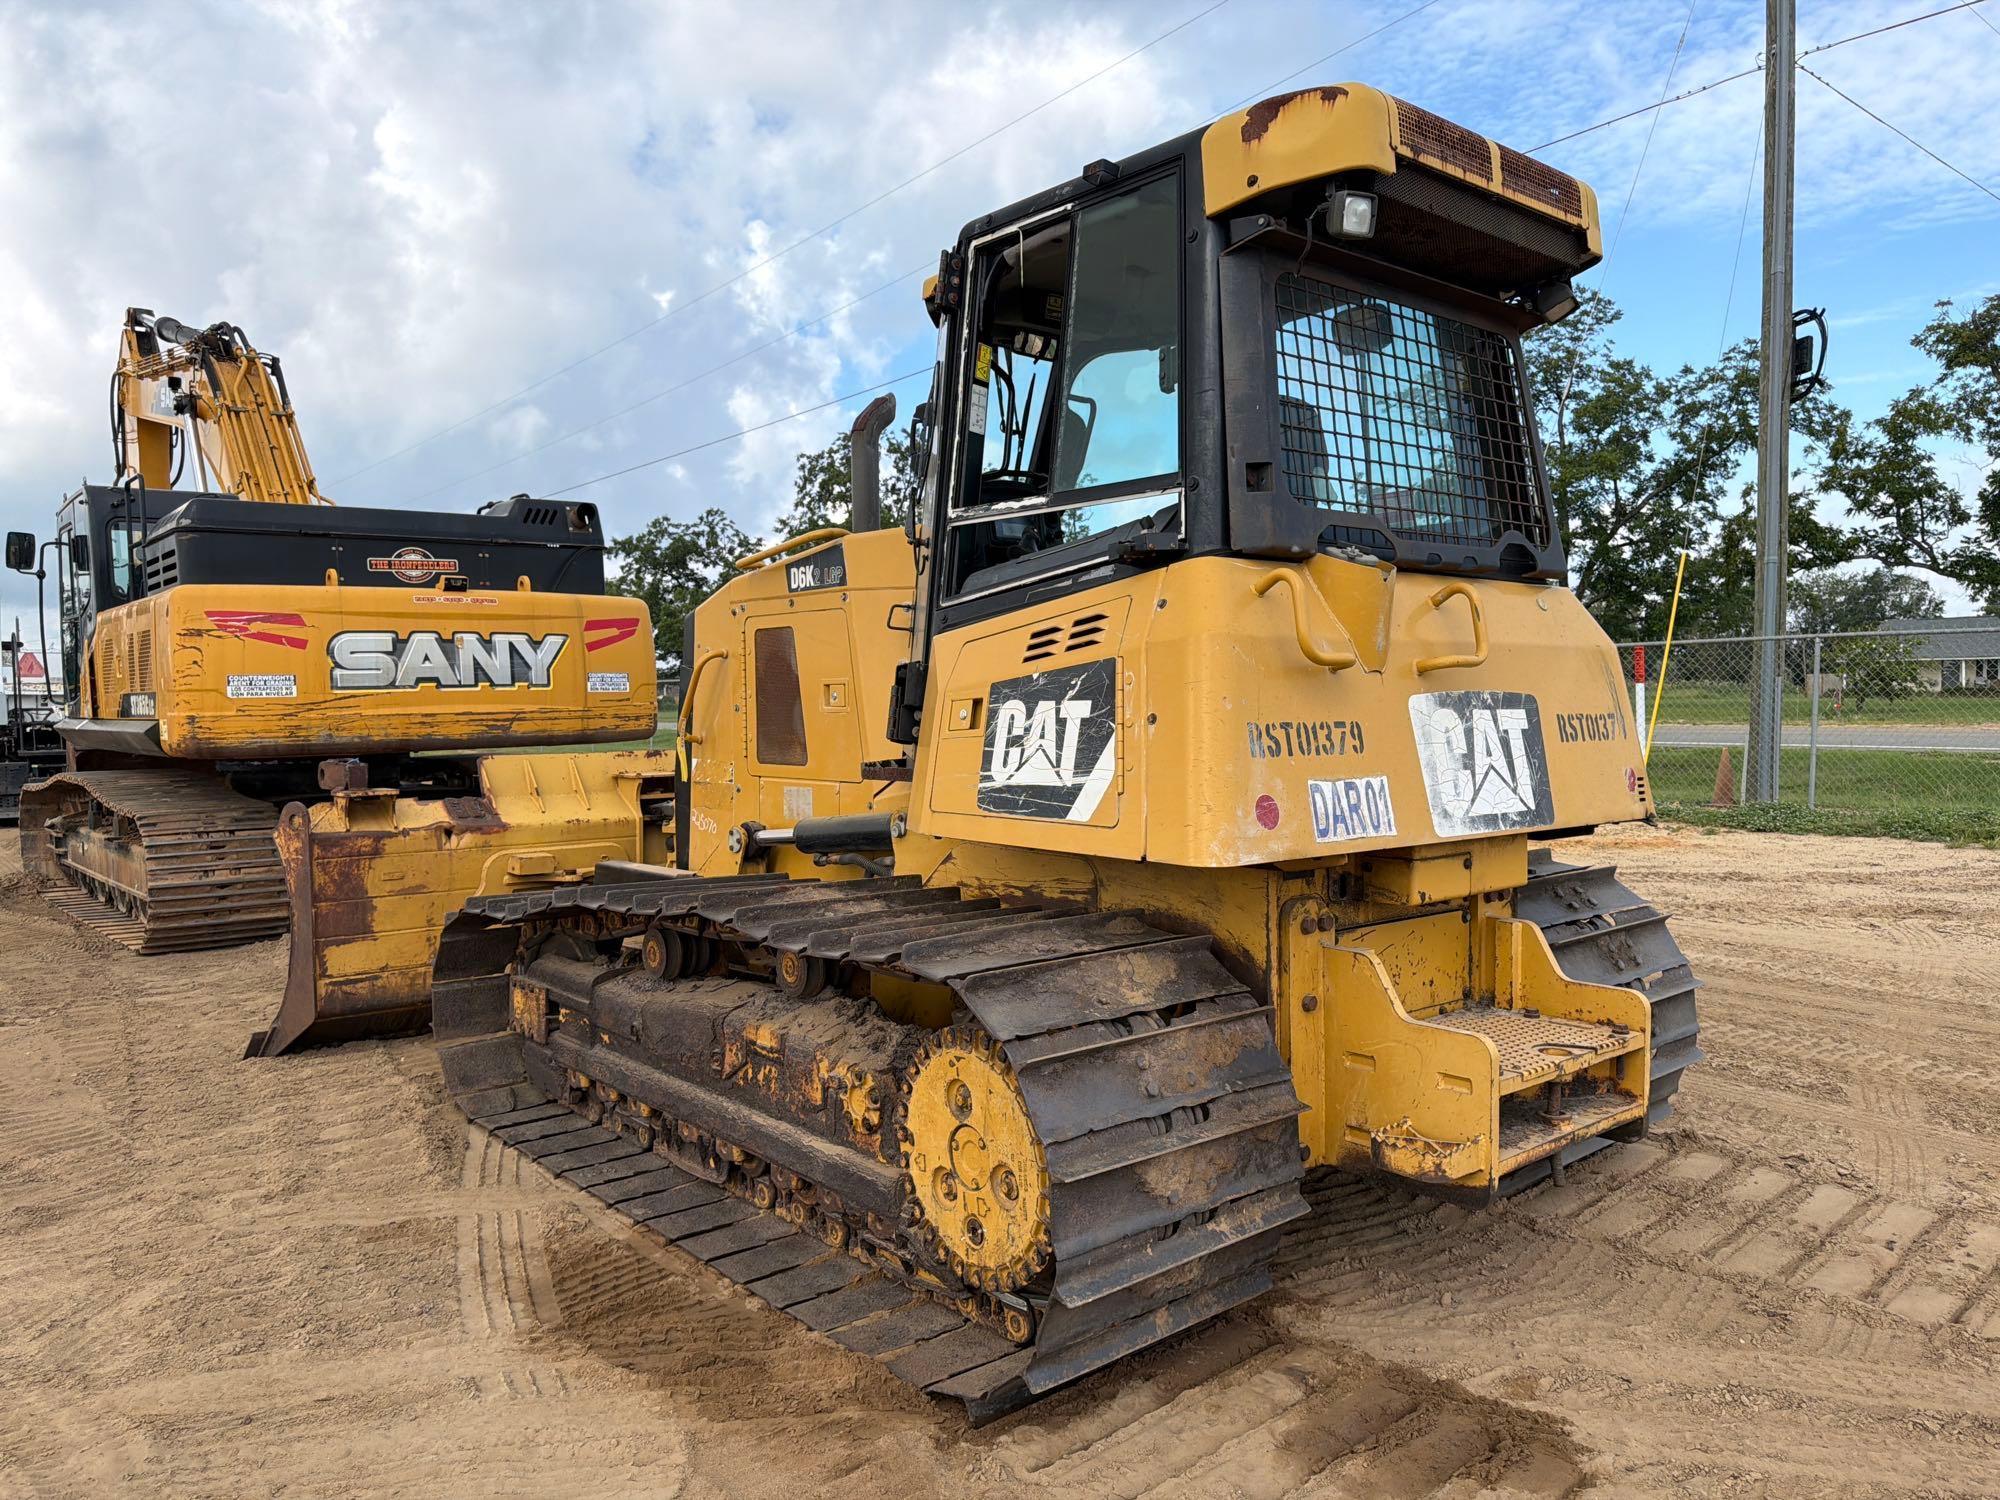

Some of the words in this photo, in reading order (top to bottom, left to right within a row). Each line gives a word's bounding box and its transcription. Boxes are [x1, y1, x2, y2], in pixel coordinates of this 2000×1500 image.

[370, 560, 389, 569] THE
[391, 560, 456, 570] IRONPEDDLERS
[331, 633, 567, 689] SANY
[990, 699, 1092, 787] CAT
[1247, 721, 1365, 759] RST01379
[1430, 708, 1536, 817] CAT
[1309, 778, 1393, 839] DAR01
